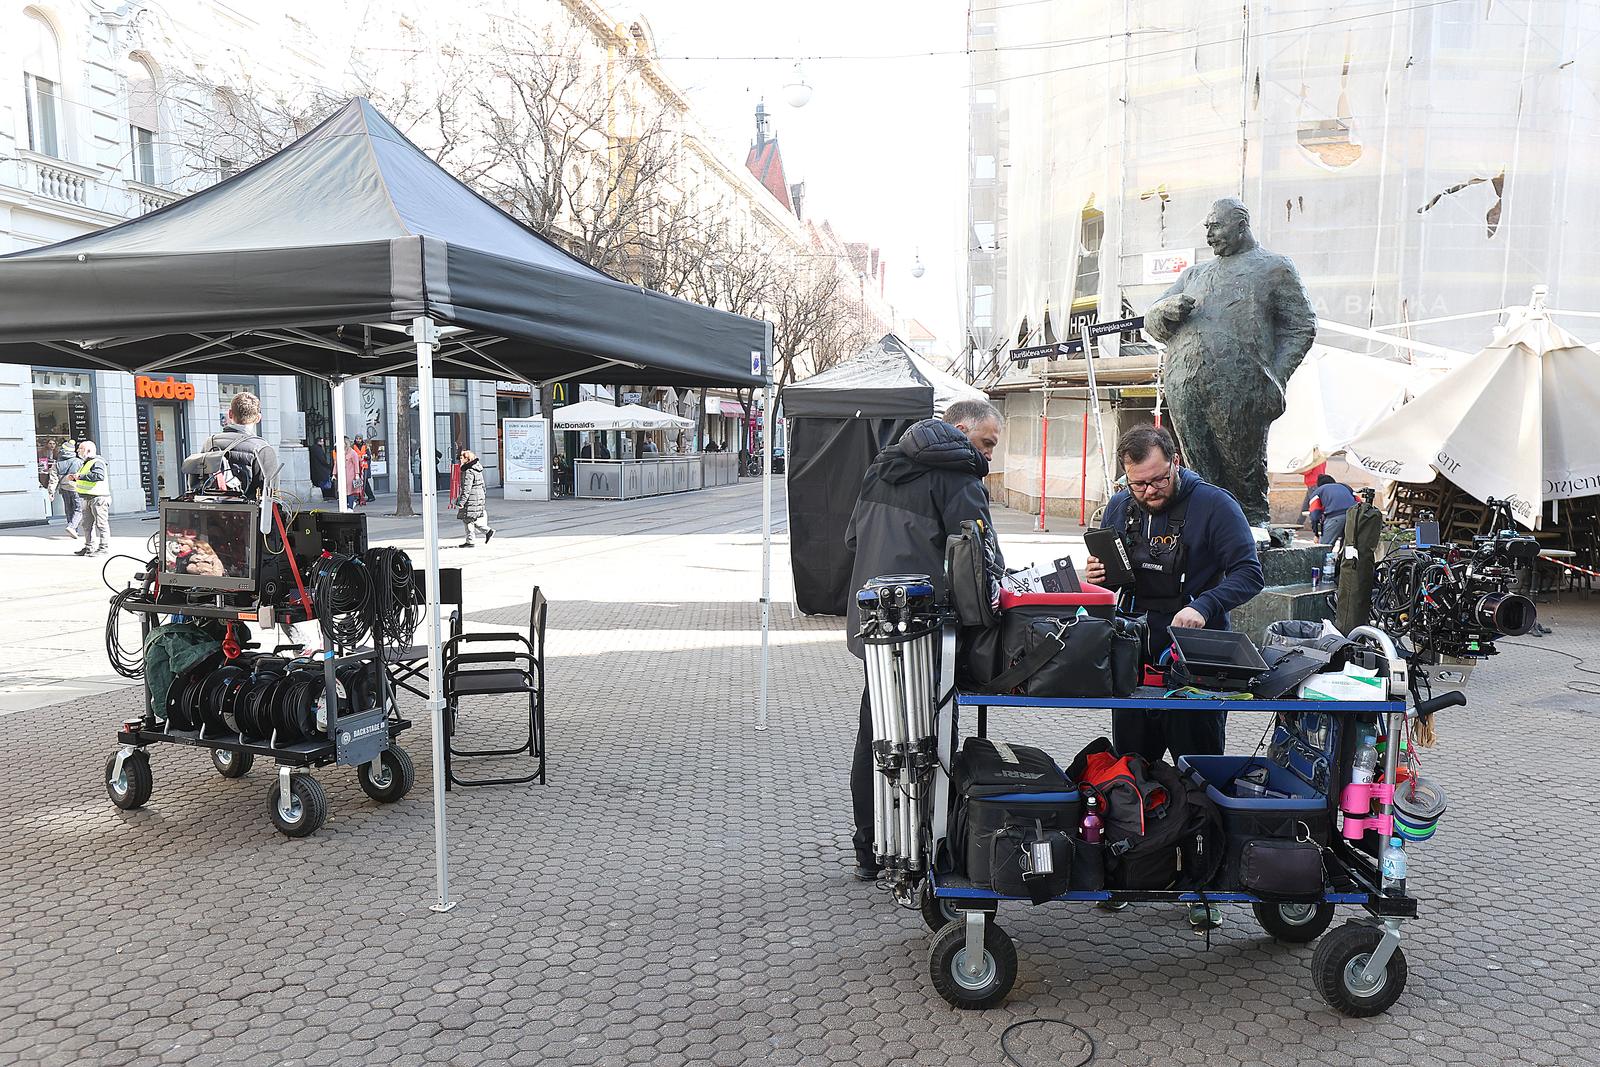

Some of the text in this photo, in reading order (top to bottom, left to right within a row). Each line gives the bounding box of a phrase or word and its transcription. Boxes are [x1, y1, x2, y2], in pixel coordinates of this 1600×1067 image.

[1092, 323, 1120, 334] Petrinjska
[136, 375, 195, 401] Rodea
[554, 422, 595, 430] McDonald's
